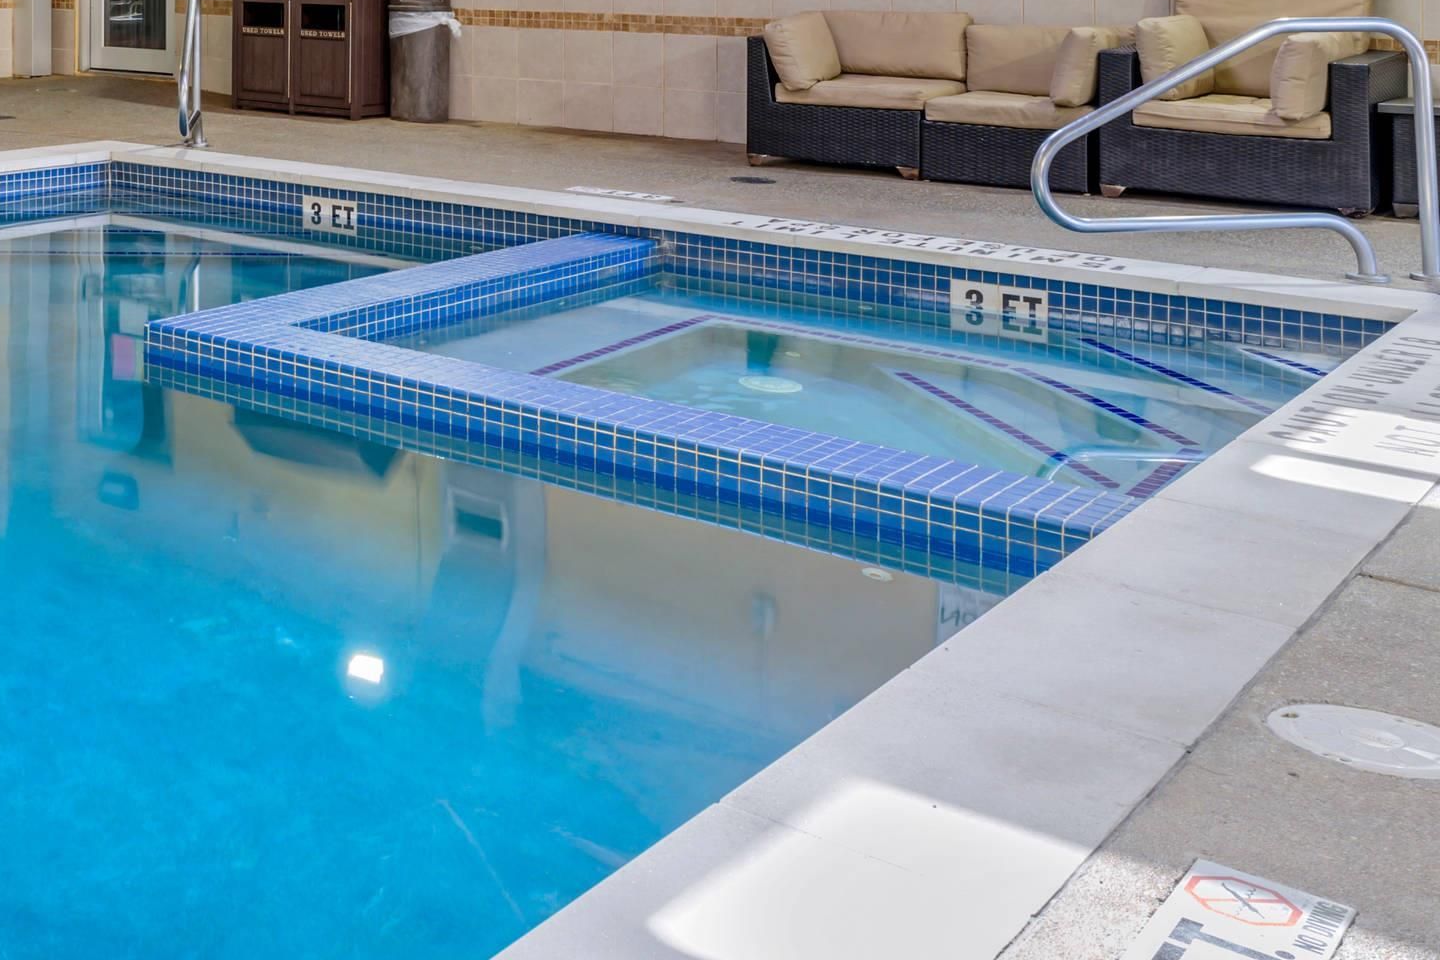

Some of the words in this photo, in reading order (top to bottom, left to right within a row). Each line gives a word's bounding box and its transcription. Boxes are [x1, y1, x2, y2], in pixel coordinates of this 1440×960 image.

[242, 26, 259, 34] USED
[260, 27, 285, 35] TOWELS
[300, 29, 317, 37] USED
[319, 30, 345, 38] TOWELS
[311, 202, 321, 224] 3
[724, 220, 860, 239] LIMIT
[879, 238, 1065, 263] MINUTE
[965, 289, 984, 324] 3
[1303, 901, 1349, 939] DIVING
[1293, 934, 1329, 956] NO
